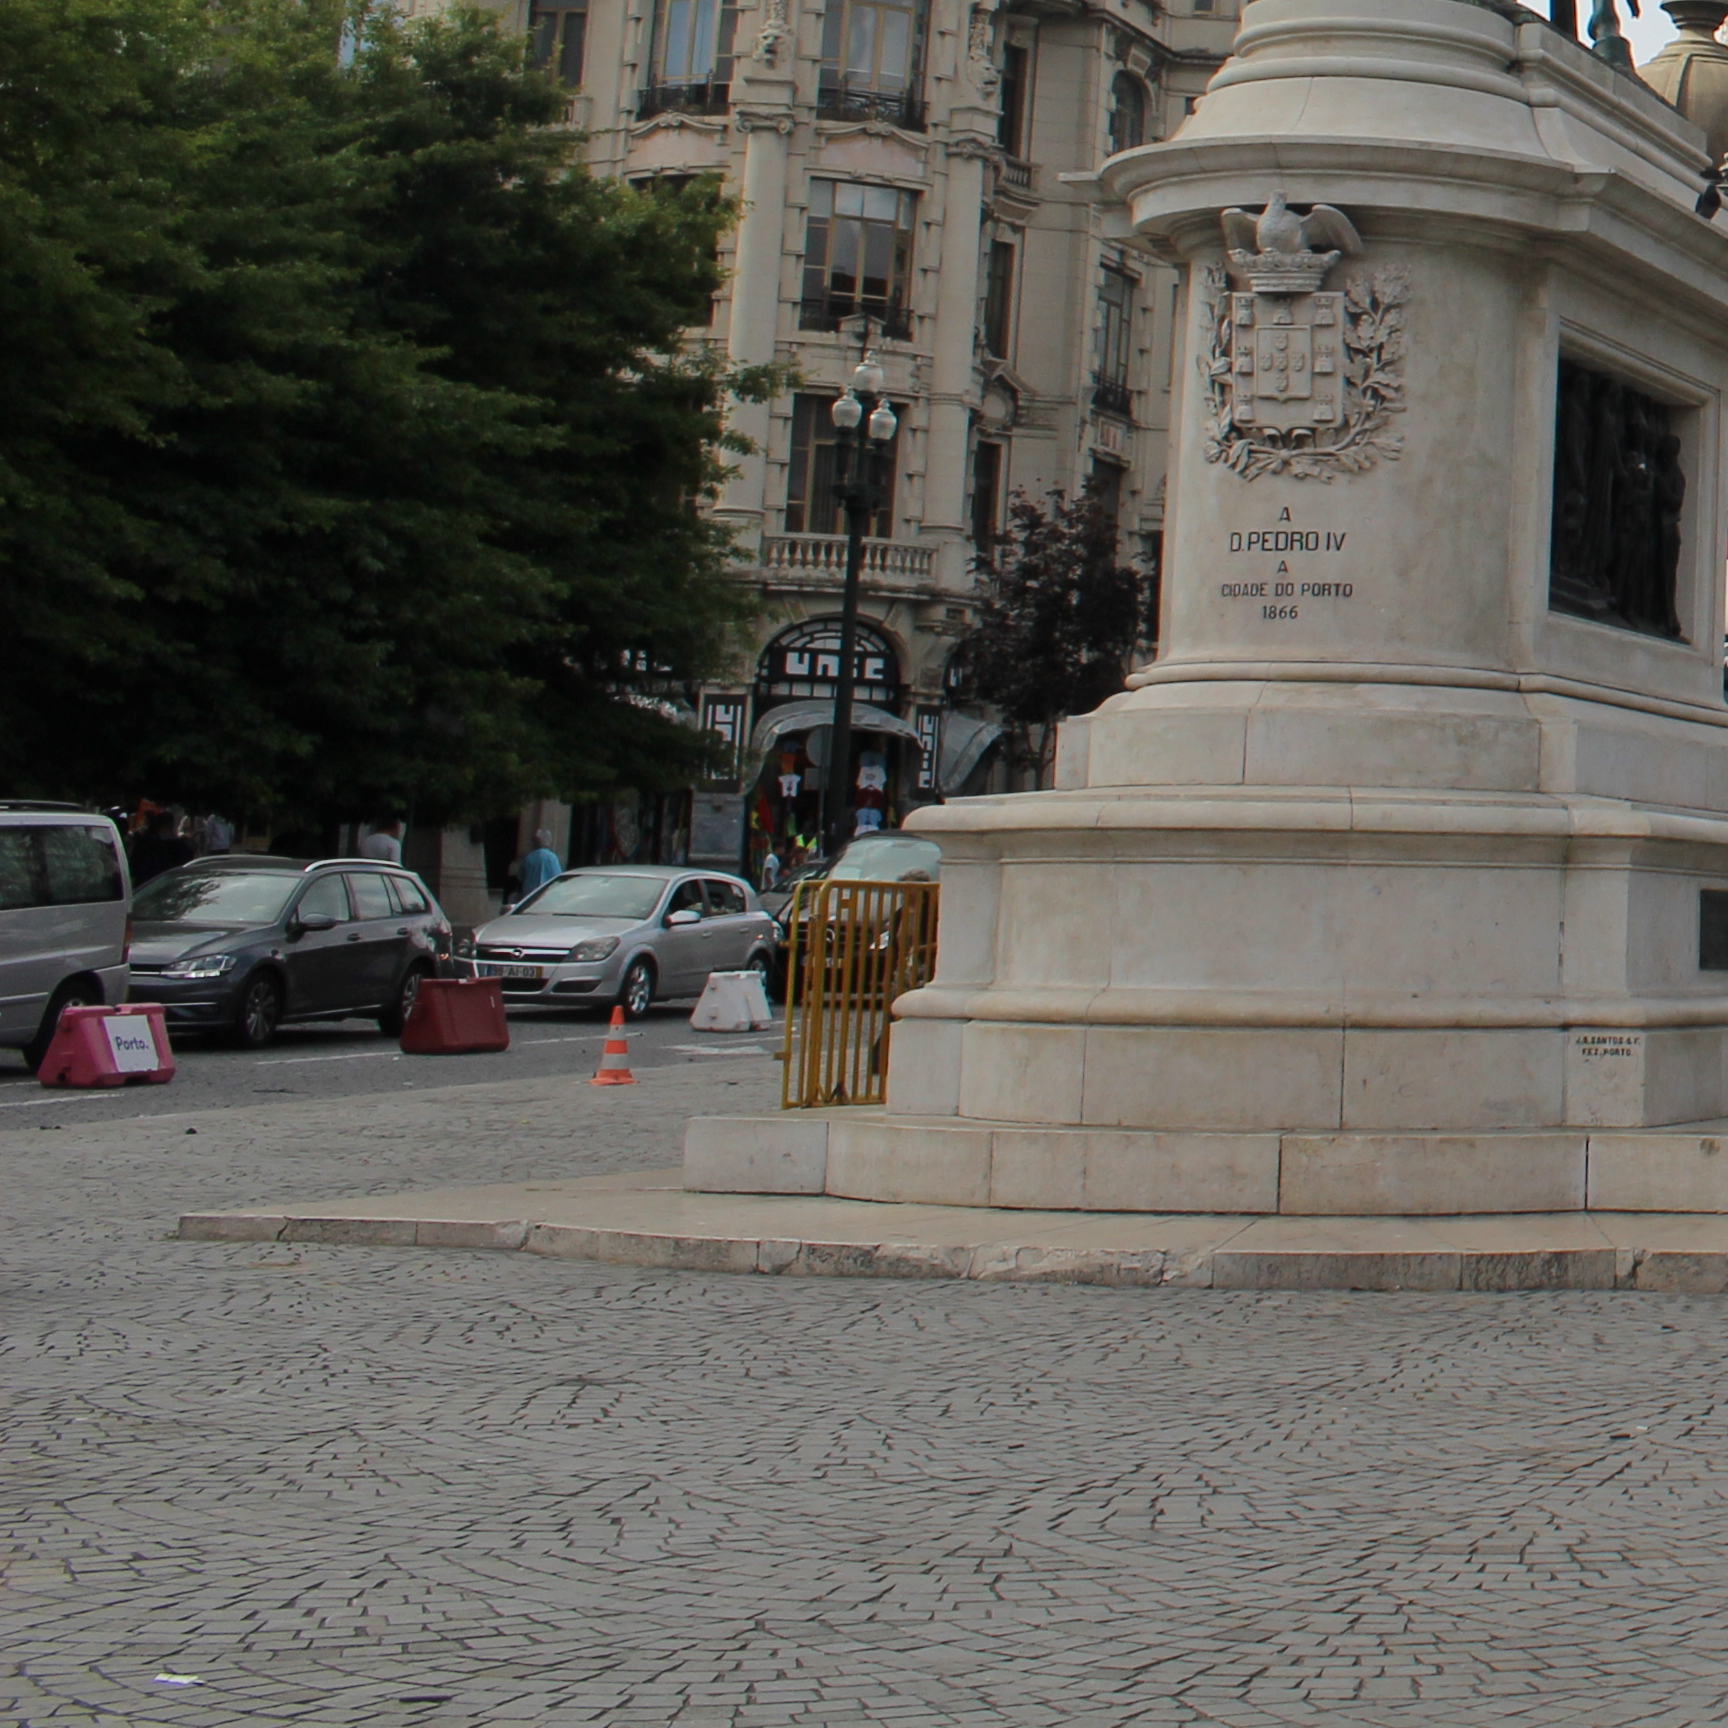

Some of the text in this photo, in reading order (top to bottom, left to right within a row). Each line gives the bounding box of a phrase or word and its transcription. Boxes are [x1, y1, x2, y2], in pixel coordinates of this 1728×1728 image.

[1279, 506, 1291, 522] A
[1326, 531, 1347, 552] IV
[1277, 560, 1289, 574] A
[1221, 582, 1353, 598] CIDADE DO PORTO
[1262, 605, 1299, 620] 1866
[115, 1036, 149, 1051] Porto.
